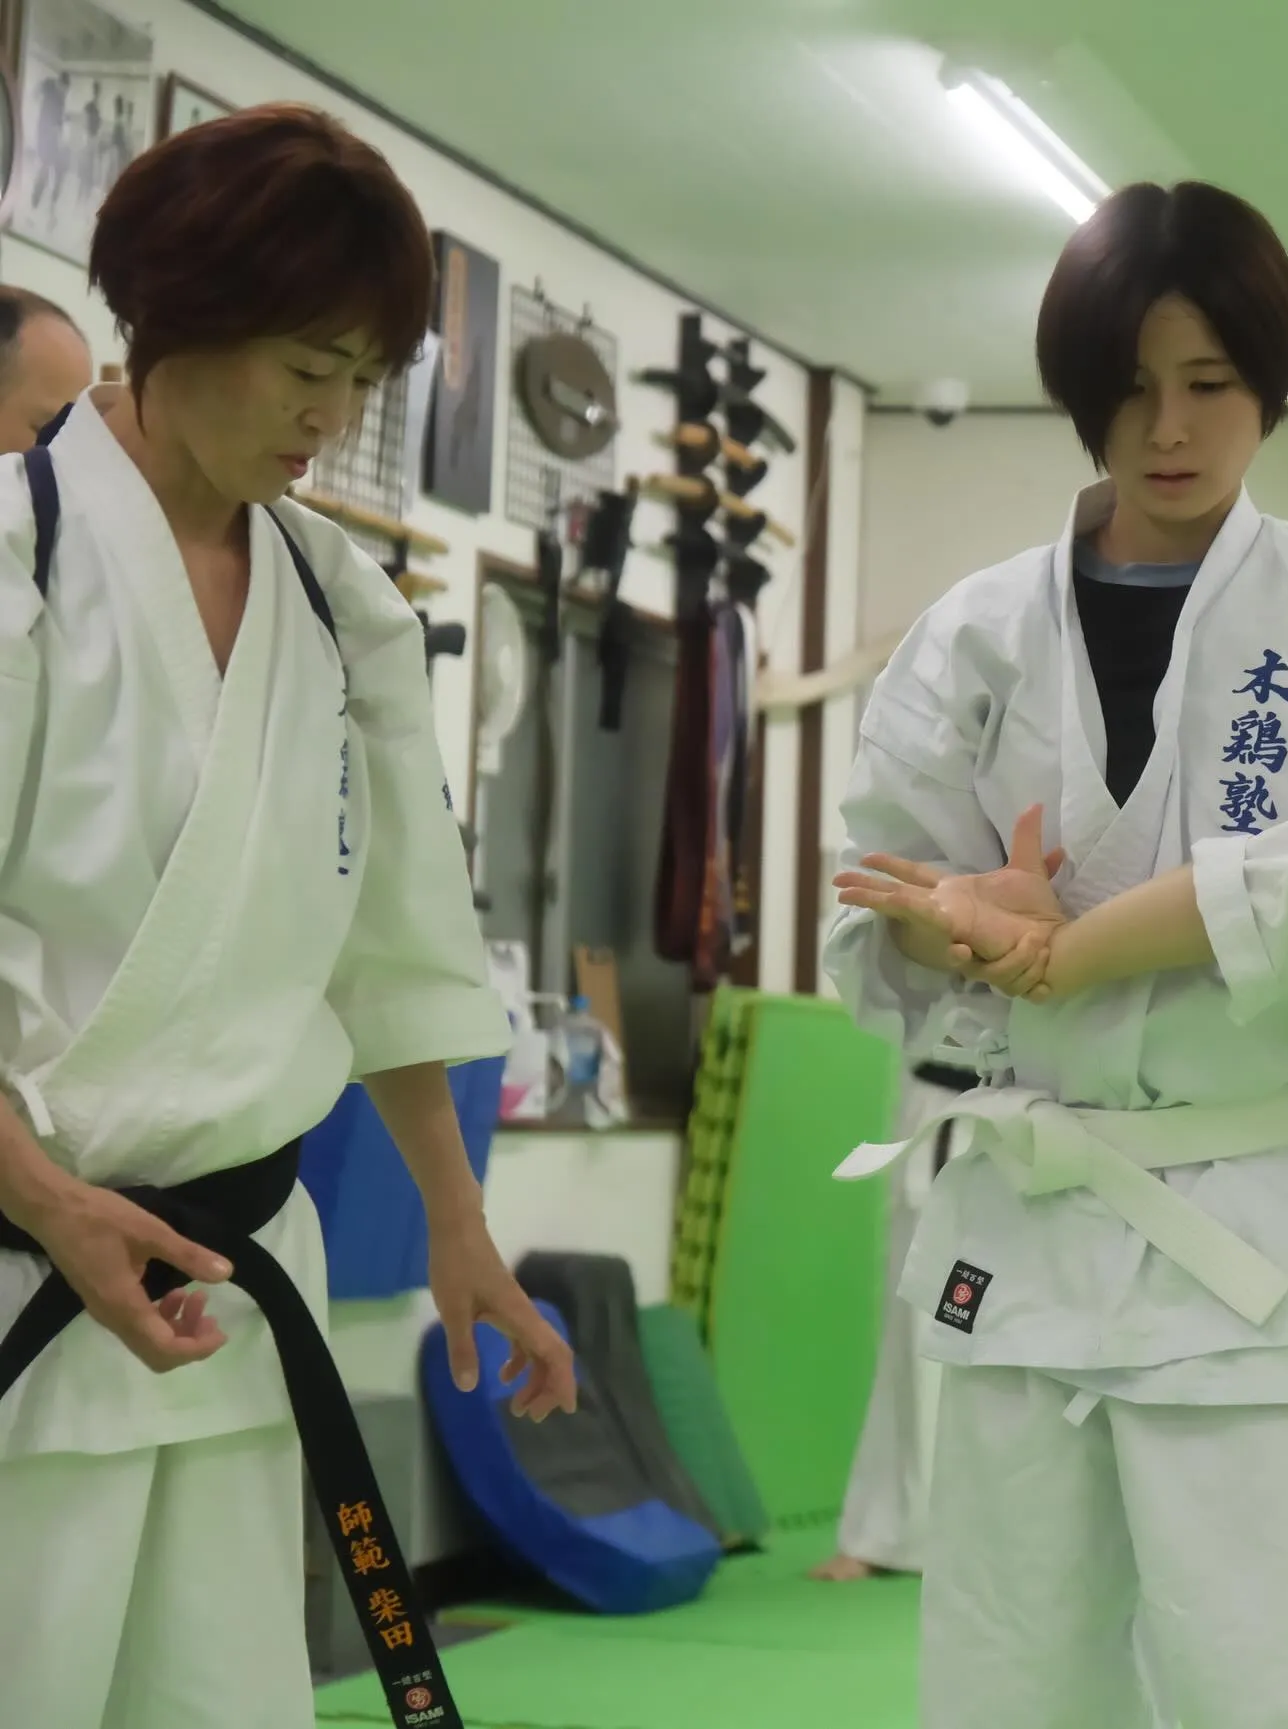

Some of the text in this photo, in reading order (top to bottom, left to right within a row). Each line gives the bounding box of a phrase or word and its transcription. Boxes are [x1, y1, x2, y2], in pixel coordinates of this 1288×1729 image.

[943, 1301, 970, 1320] ISAMI
[336, 1501, 390, 1575] 師範
[368, 1588, 413, 1650] 柴田
[405, 1706, 444, 1724] ISAMI
